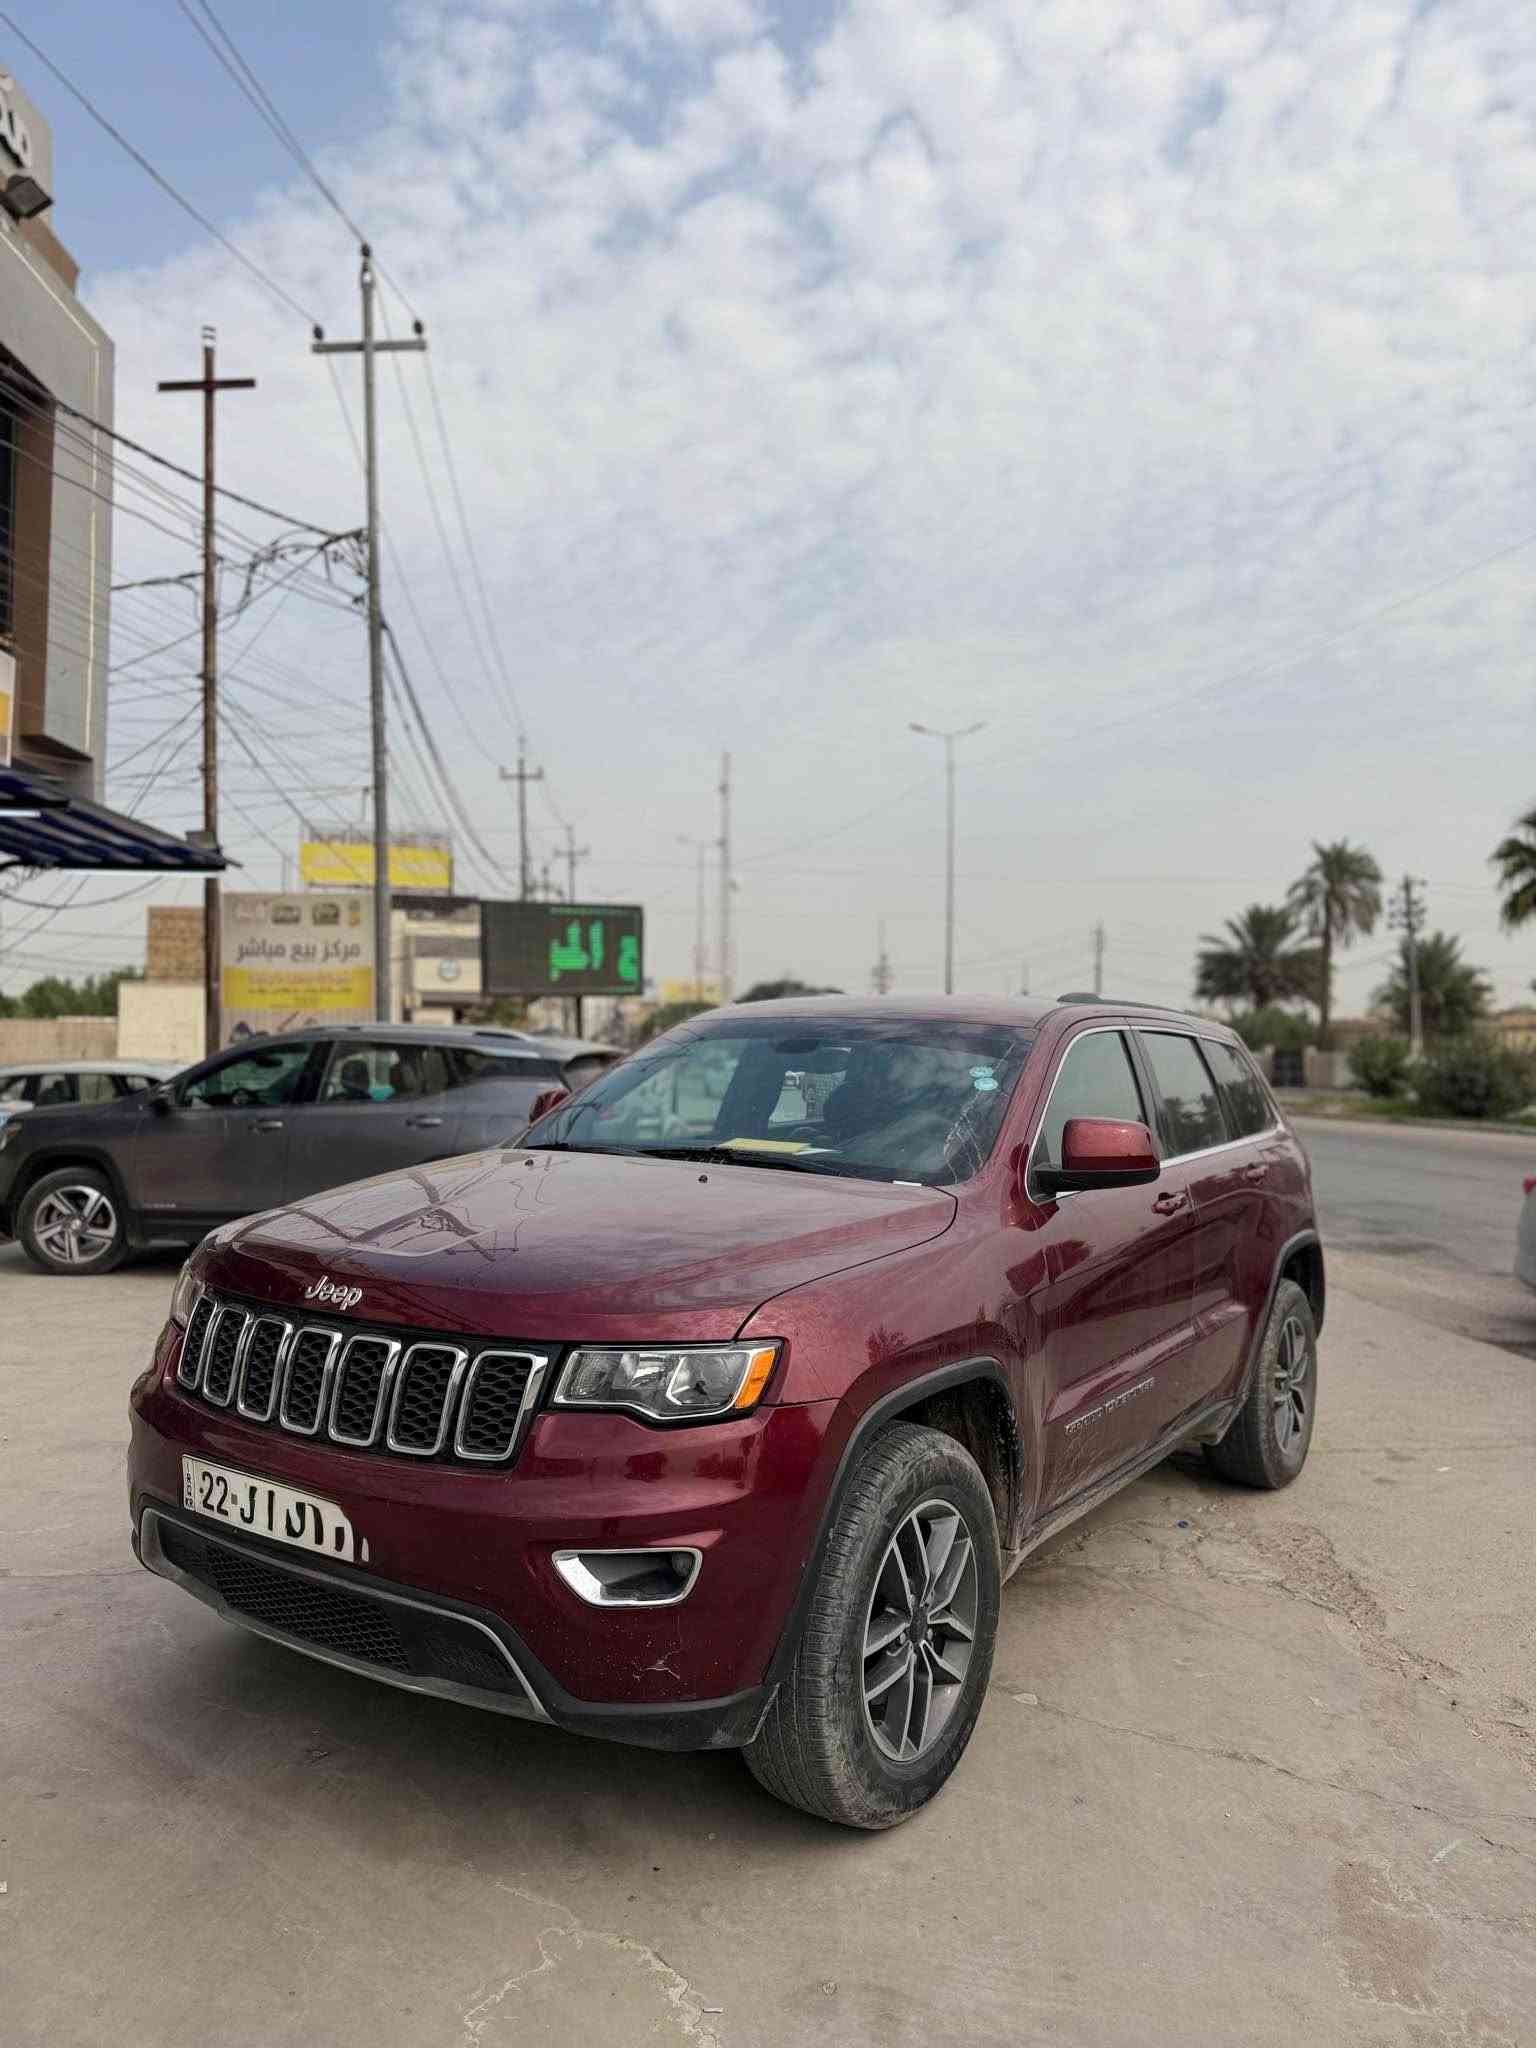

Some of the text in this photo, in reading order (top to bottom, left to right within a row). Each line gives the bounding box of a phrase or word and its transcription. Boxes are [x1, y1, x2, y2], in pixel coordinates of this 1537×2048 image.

[235, 936, 361, 963] مركز بيع مباشر
[304, 1274, 363, 1311] Jeep
